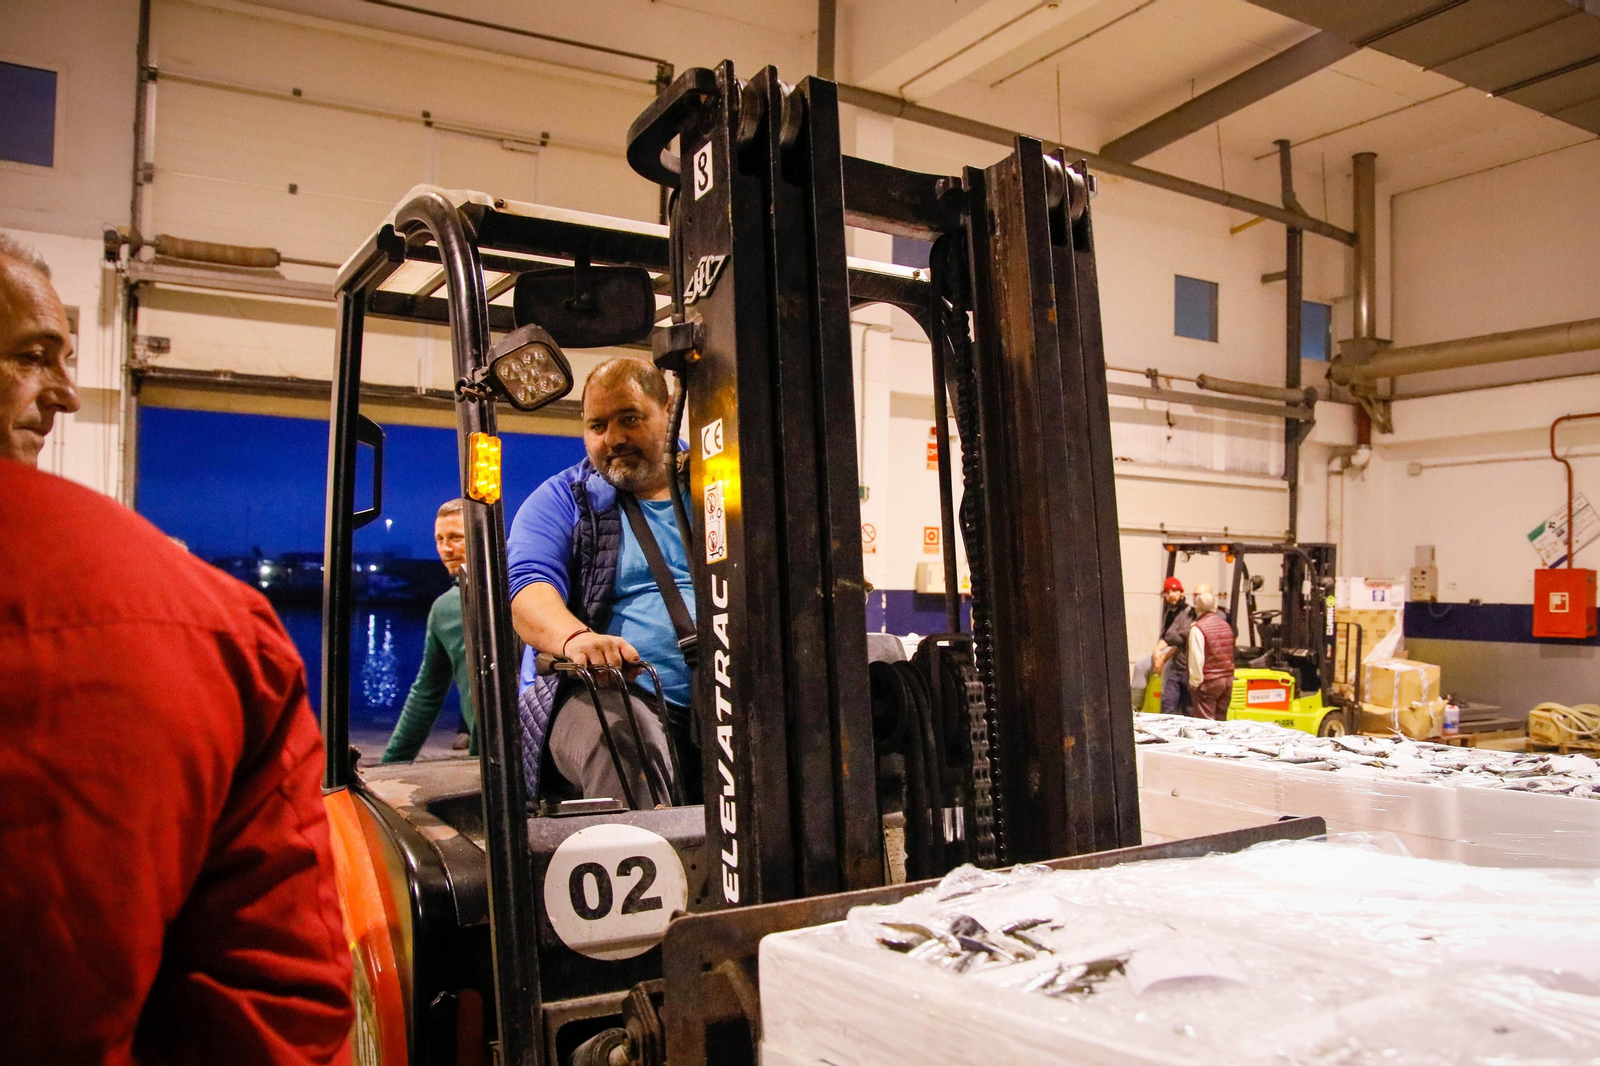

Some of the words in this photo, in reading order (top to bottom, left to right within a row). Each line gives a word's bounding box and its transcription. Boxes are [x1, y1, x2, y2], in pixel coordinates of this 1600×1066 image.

[703, 421, 722, 455] CE
[711, 573, 740, 904] ELEVATRAC
[569, 855, 663, 920] 02
